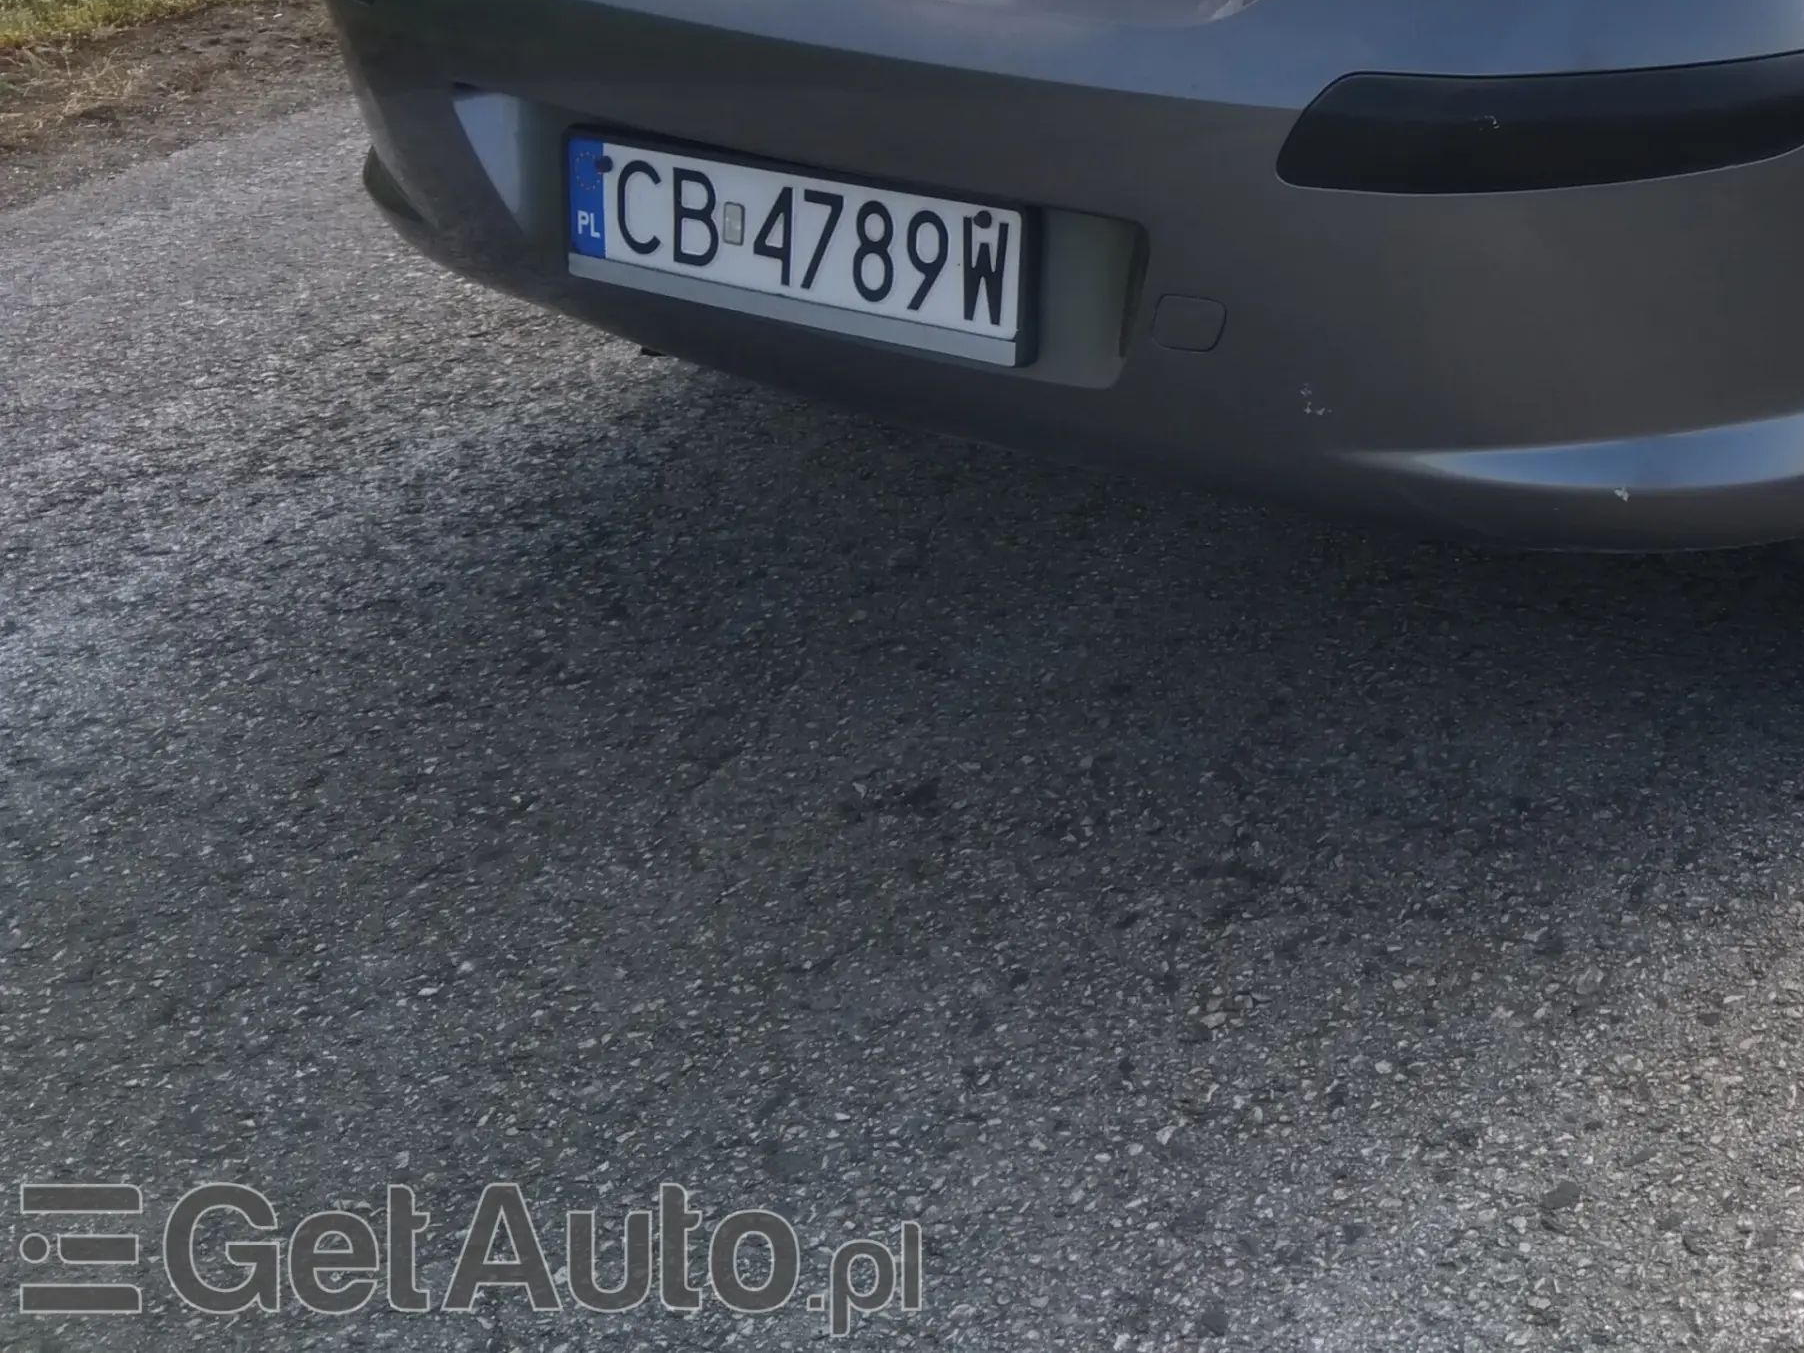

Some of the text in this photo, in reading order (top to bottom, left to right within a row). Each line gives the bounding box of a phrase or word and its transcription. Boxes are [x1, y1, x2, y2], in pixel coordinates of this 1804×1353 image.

[576, 209, 600, 239] PL
[617, 160, 1009, 326] CB 4789W
